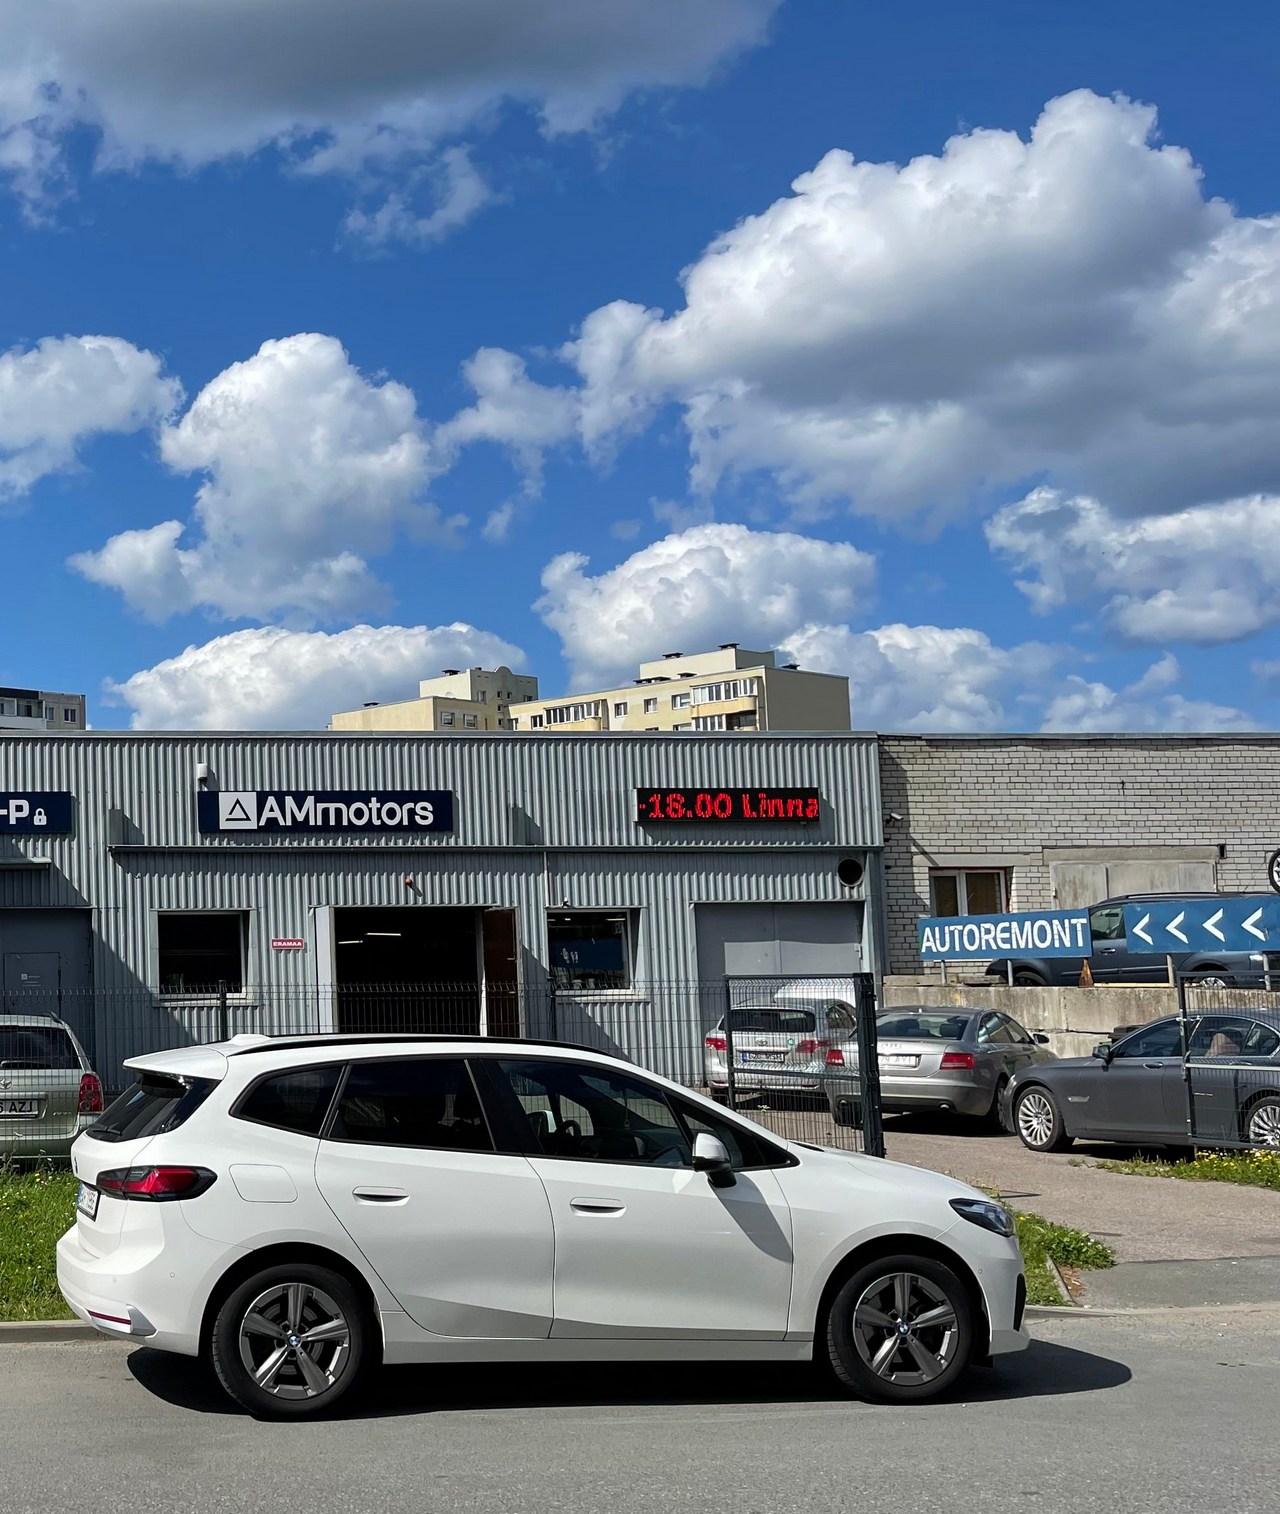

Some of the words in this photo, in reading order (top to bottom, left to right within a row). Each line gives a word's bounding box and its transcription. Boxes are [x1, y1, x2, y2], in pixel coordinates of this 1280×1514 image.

[258, 796, 434, 826] AMmotors
[921, 917, 1088, 953] AUTOREMONT
[9, 1101, 33, 1113] AZJ
